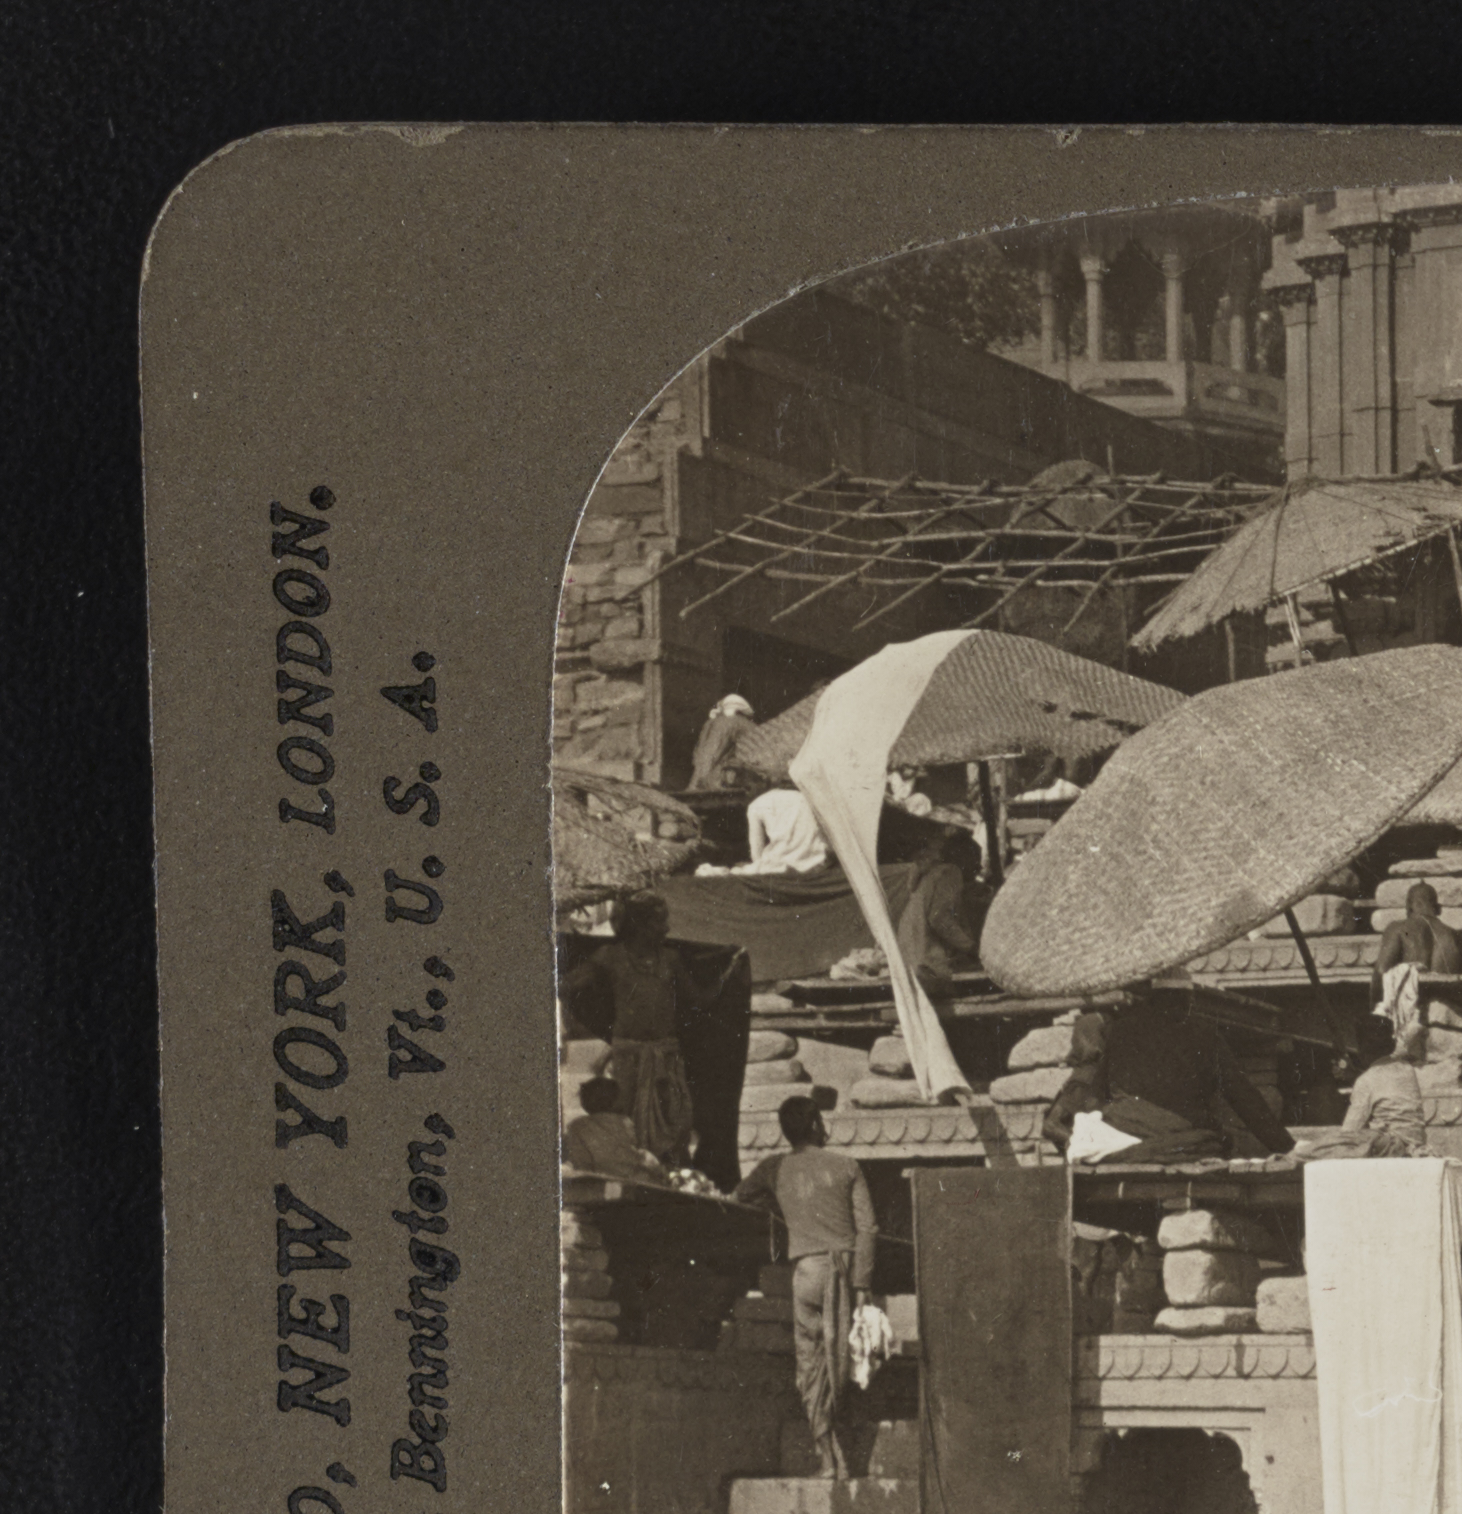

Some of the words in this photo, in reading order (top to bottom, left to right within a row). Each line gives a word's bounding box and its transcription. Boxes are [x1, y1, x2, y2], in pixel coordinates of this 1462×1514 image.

[268, 484, 337, 835] LONDON.
[379, 650, 438, 734] A.
[381, 761, 442, 828] S.
[383, 854, 445, 926] U.
[269, 869, 355, 1149] YORK,
[386, 955, 455, 1080] Vt.,
[273, 1182, 352, 1428] NEW
[389, 1112, 461, 1494] Bennington,
